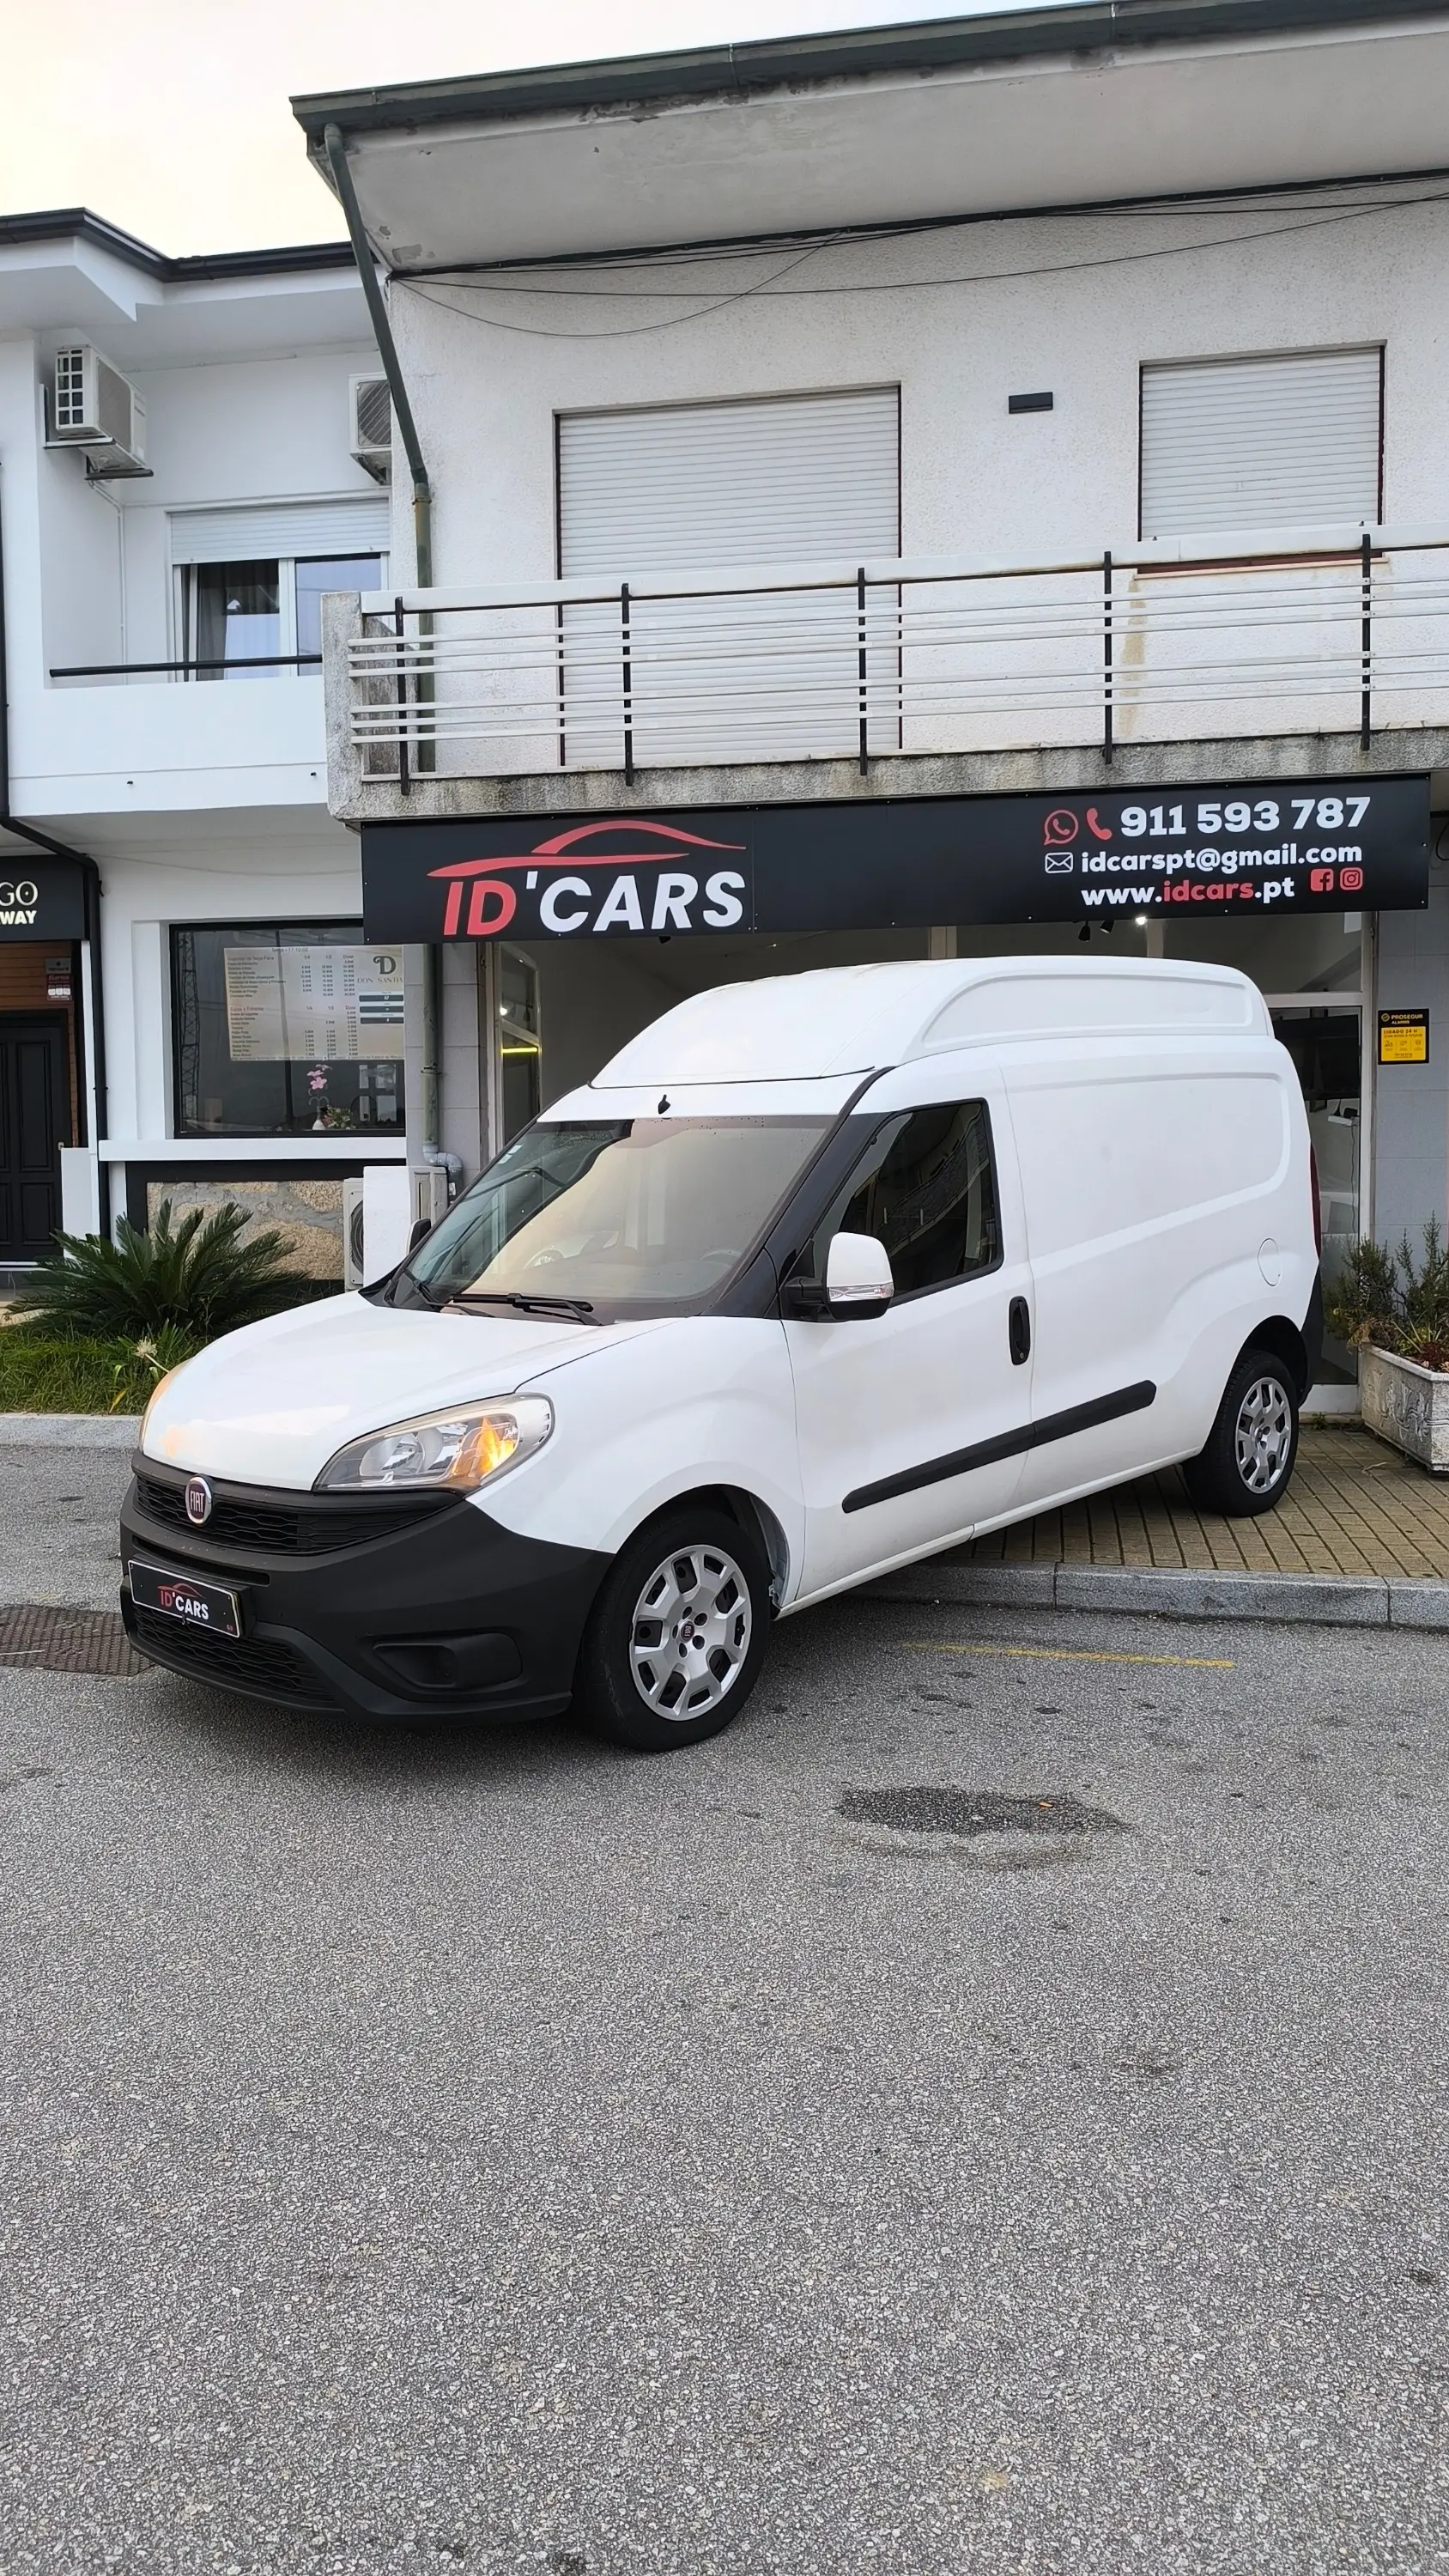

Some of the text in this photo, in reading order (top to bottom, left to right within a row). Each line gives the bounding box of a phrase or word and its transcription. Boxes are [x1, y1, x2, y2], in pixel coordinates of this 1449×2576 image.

[1120, 796, 1371, 837] 911 593 787
[1082, 842, 1362, 875] idcarspt@gmail.com
[443, 870, 746, 936] ID'CARS
[1081, 877, 1295, 906] www.idcars.pt
[373, 955, 397, 975] D
[190, 1490, 205, 1513] FIAT
[161, 1590, 209, 1619] ID'CARS
